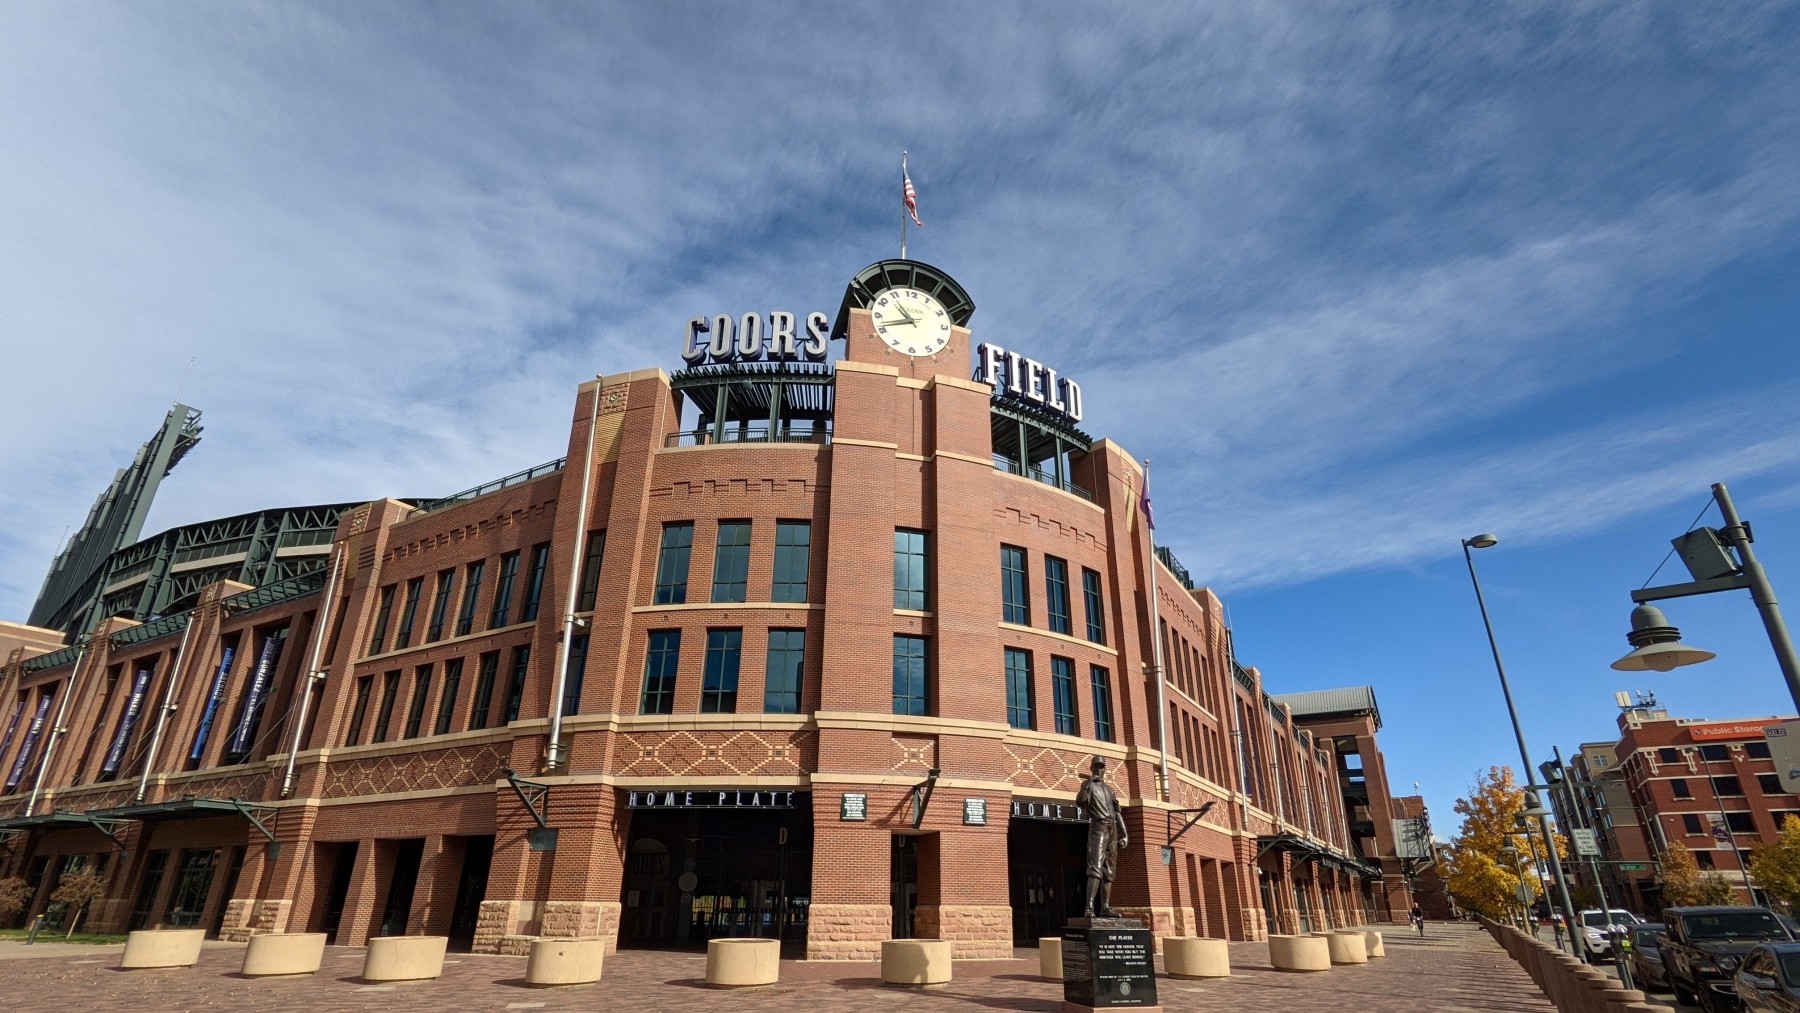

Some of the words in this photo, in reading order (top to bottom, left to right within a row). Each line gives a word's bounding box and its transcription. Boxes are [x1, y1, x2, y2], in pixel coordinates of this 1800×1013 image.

[878, 298, 888, 307] 10
[905, 291, 918, 299] 12
[903, 306, 924, 315] ULOVA
[682, 311, 829, 362] COORS
[977, 342, 1083, 422] FIELD
[253, 659, 271, 693] GONZALEZ
[213, 671, 229, 701] ARENADO
[127, 693, 143, 716] WALKER
[1702, 727, 1734, 736] Public
[1734, 725, 1764, 734] Storag
[629, 792, 693, 806] HOME
[718, 792, 793, 806] PLATE
[1013, 801, 1062, 818] HOME
[778, 827, 788, 845] D
